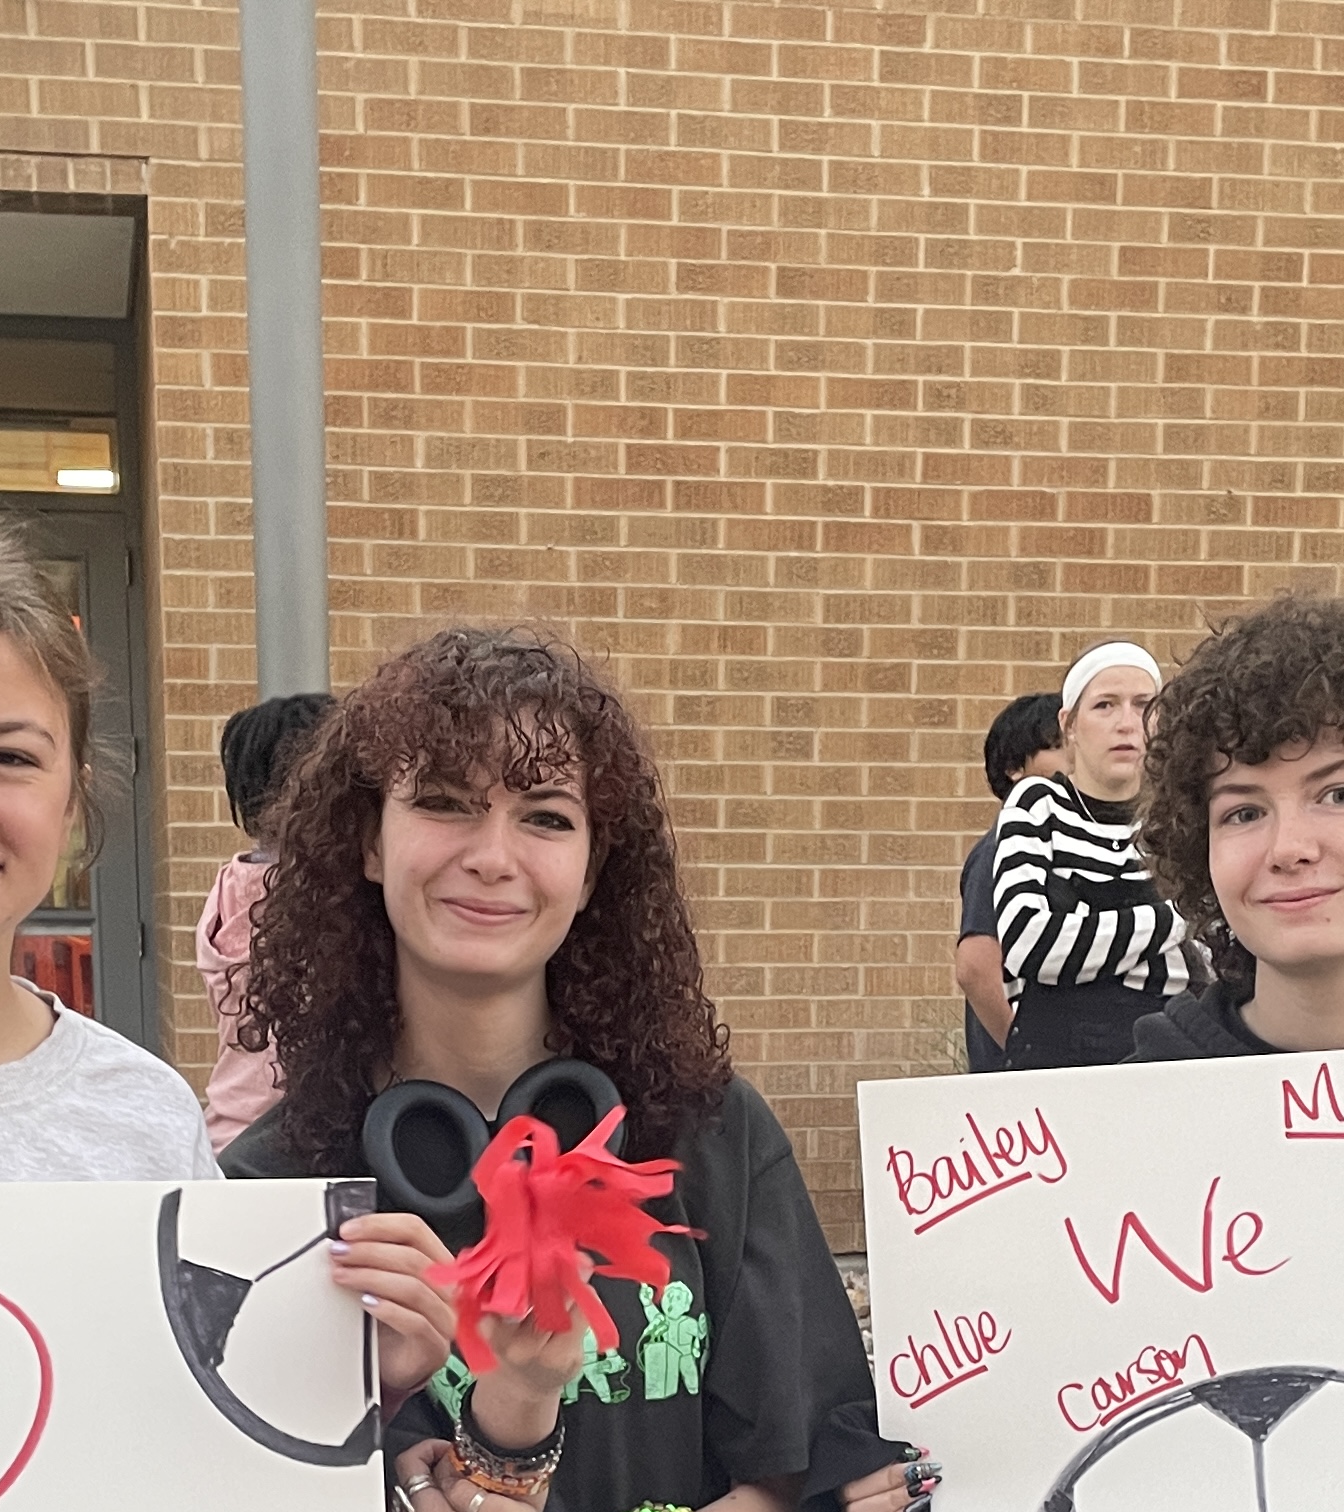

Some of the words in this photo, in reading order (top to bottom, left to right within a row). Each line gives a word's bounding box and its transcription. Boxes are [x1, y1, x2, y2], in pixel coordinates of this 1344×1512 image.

[887, 1108, 1067, 1216] Bailey
[1064, 1176, 1292, 1304] We
[1057, 1333, 1216, 1433] Carson
